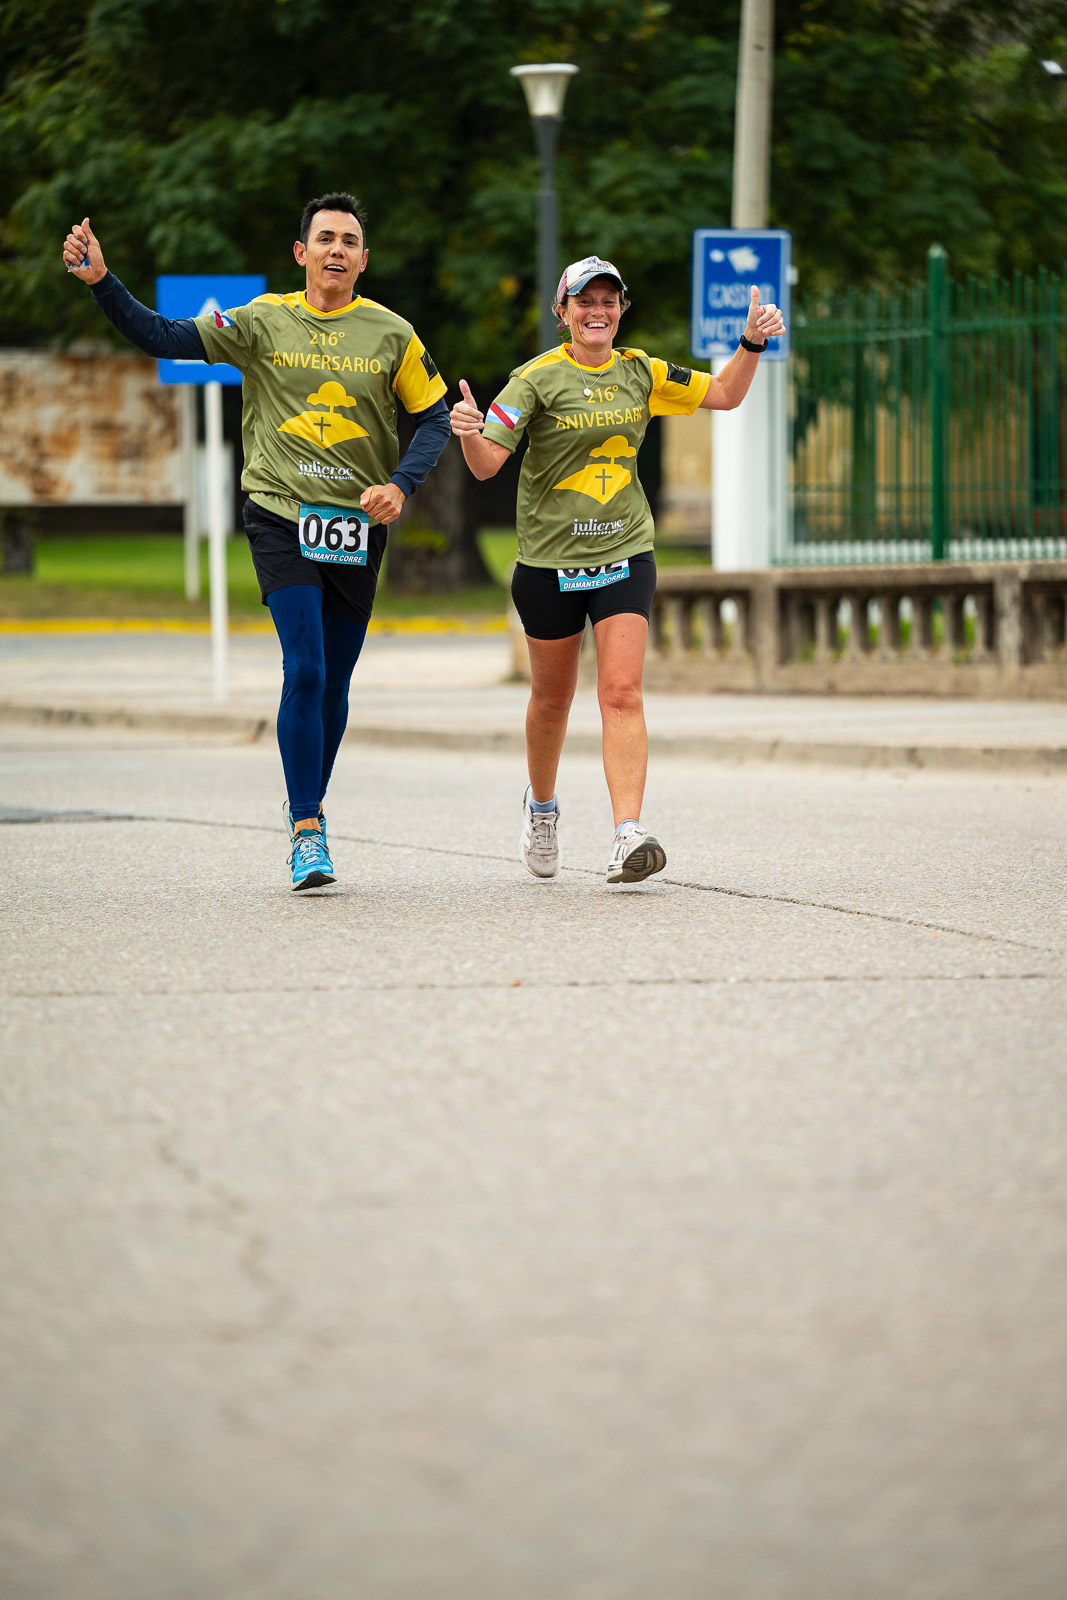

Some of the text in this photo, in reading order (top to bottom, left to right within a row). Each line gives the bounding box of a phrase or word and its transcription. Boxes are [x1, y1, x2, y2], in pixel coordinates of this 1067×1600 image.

[272, 350, 381, 374] ANIVERSARIO
[298, 460, 354, 476] julicroc
[303, 512, 362, 554] 063
[304, 550, 363, 563] DIAMANTE CORRE
[563, 579, 601, 590] DIAMANTE
[602, 571, 626, 585] CORRE
